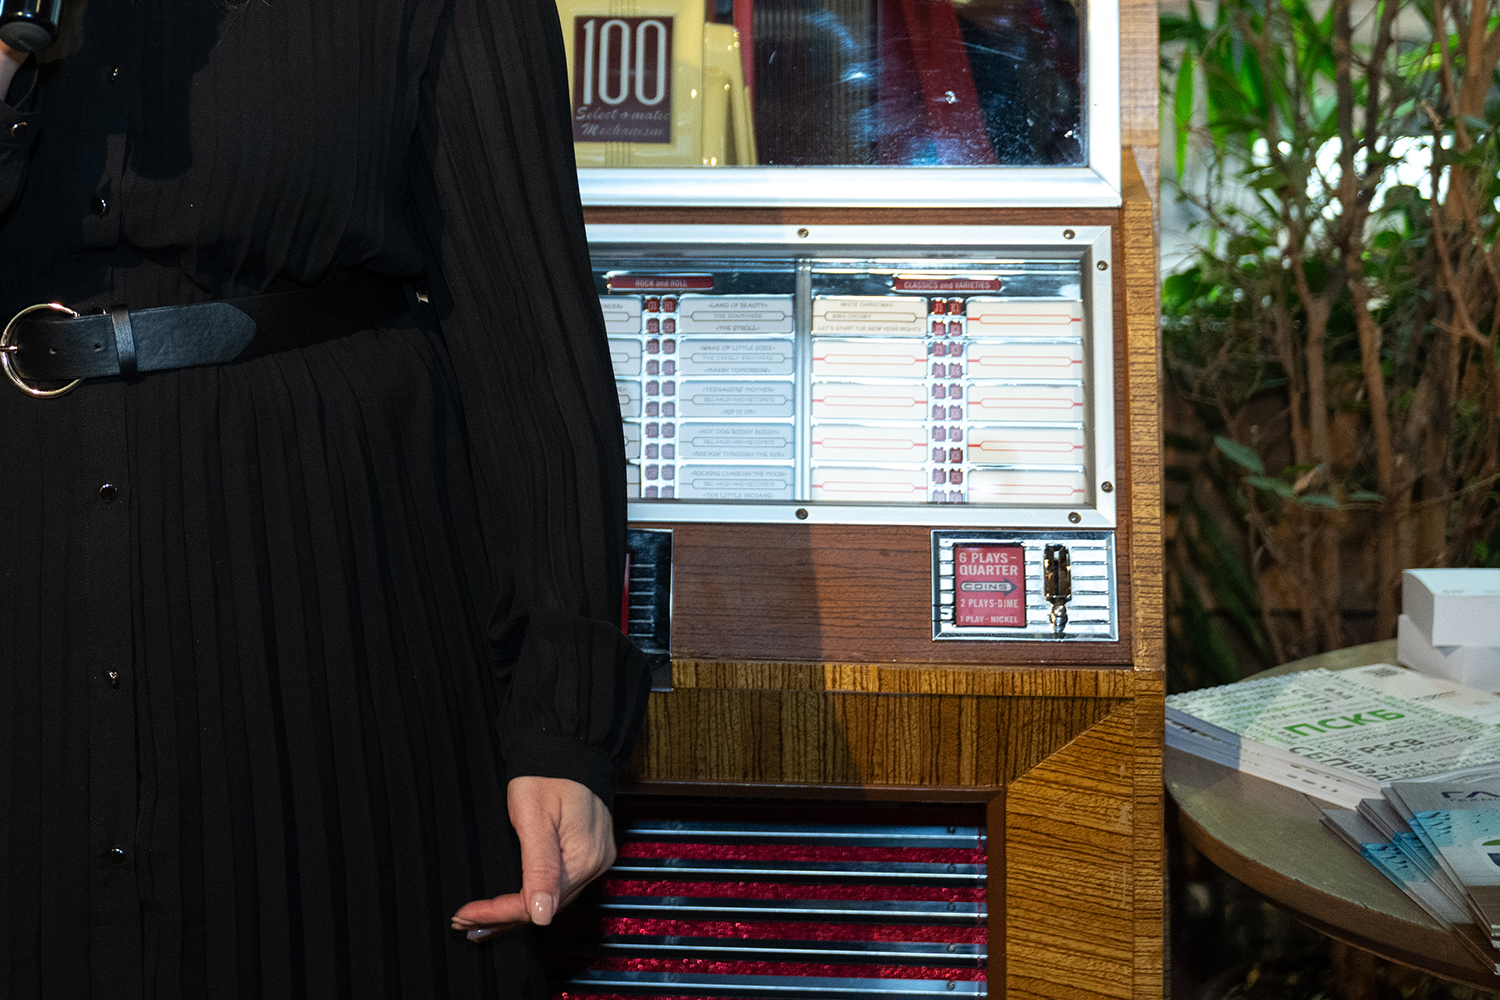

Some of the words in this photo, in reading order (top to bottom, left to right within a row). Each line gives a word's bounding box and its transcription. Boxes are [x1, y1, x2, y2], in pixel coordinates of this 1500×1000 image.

[583, 19, 666, 105] 100
[582, 123, 663, 136] Mechanism
[635, 279, 654, 287] ROCK
[655, 279, 669, 287] and
[904, 281, 938, 289] CLASSICS
[959, 552, 967, 563] 6
[959, 565, 1018, 576] QUARTER
[961, 599, 966, 607] 2
[1283, 709, 1405, 737] ПСКБ
